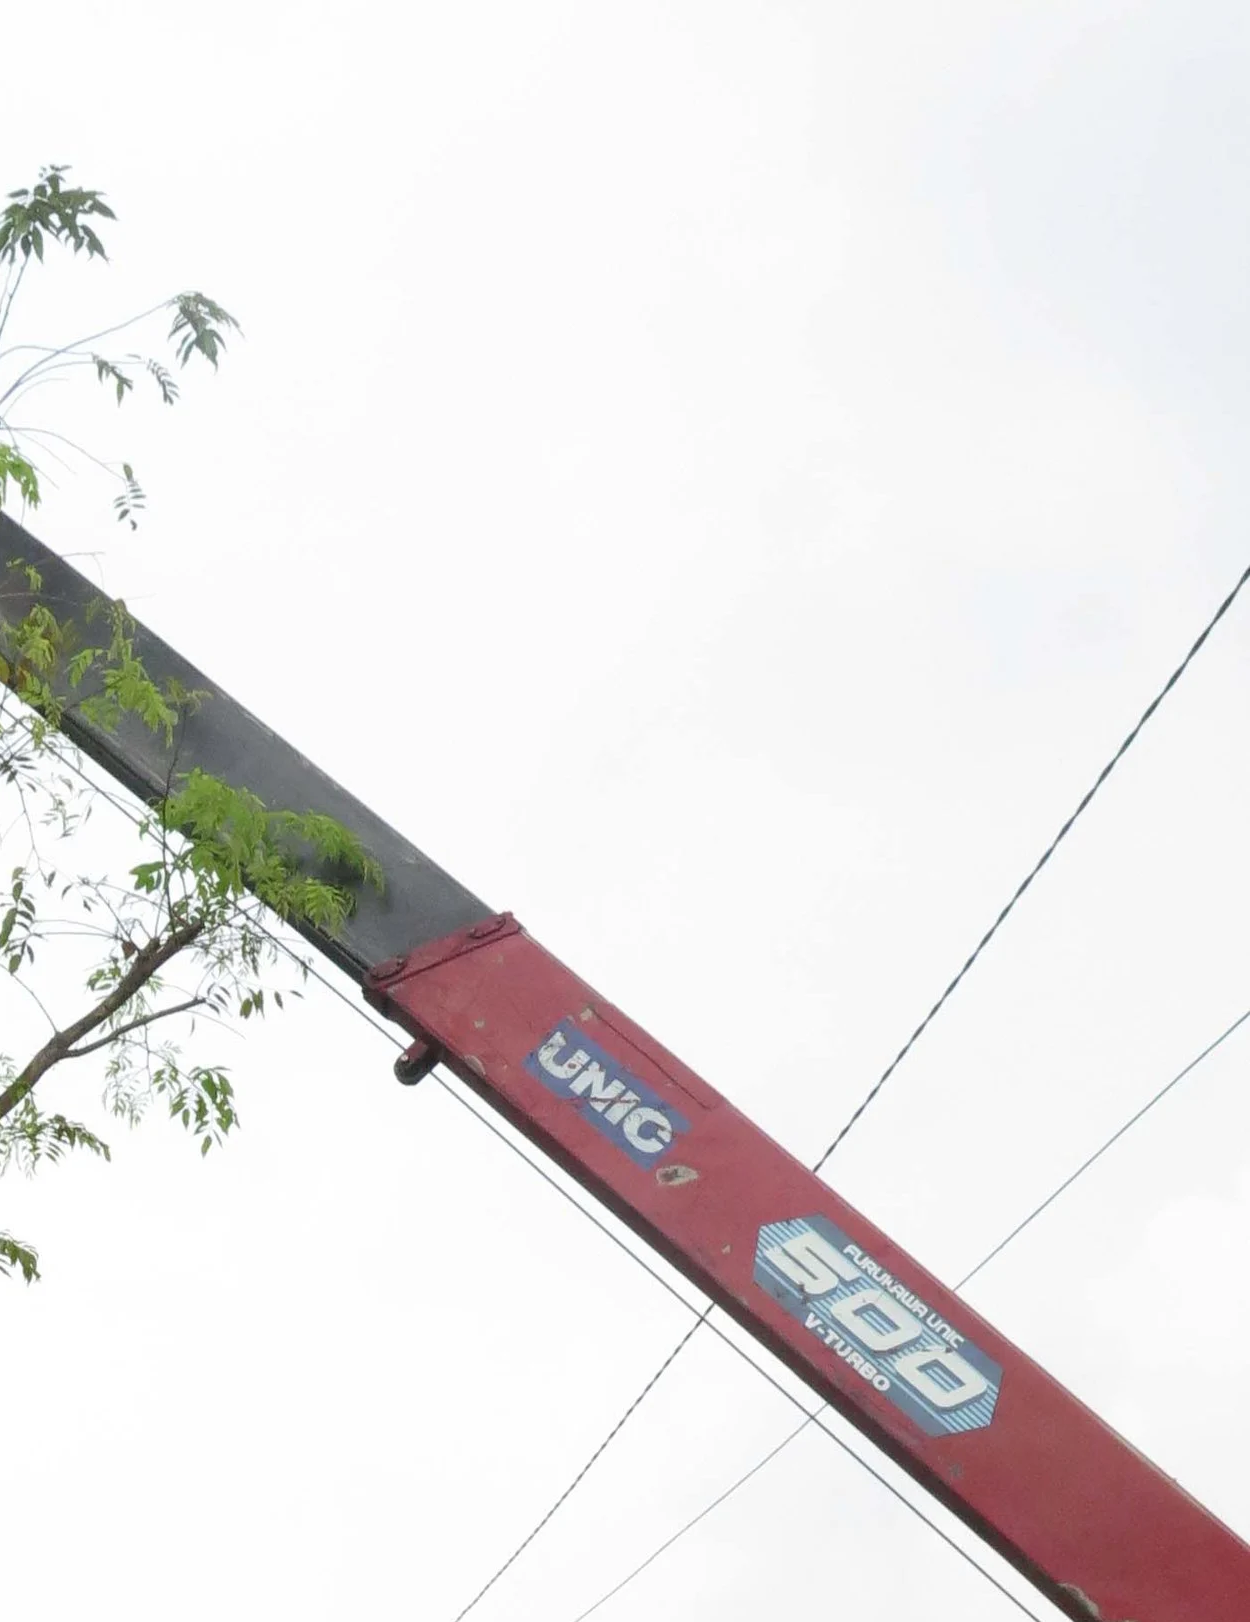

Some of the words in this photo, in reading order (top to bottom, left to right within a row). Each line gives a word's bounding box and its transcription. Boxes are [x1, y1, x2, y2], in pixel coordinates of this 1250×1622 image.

[538, 1031, 673, 1154] UNIC
[763, 1231, 988, 1408] 500
[804, 1312, 891, 1392] V-TURBO
[843, 1244, 929, 1320] FURUKAWA
[925, 1313, 965, 1349] UNIC
